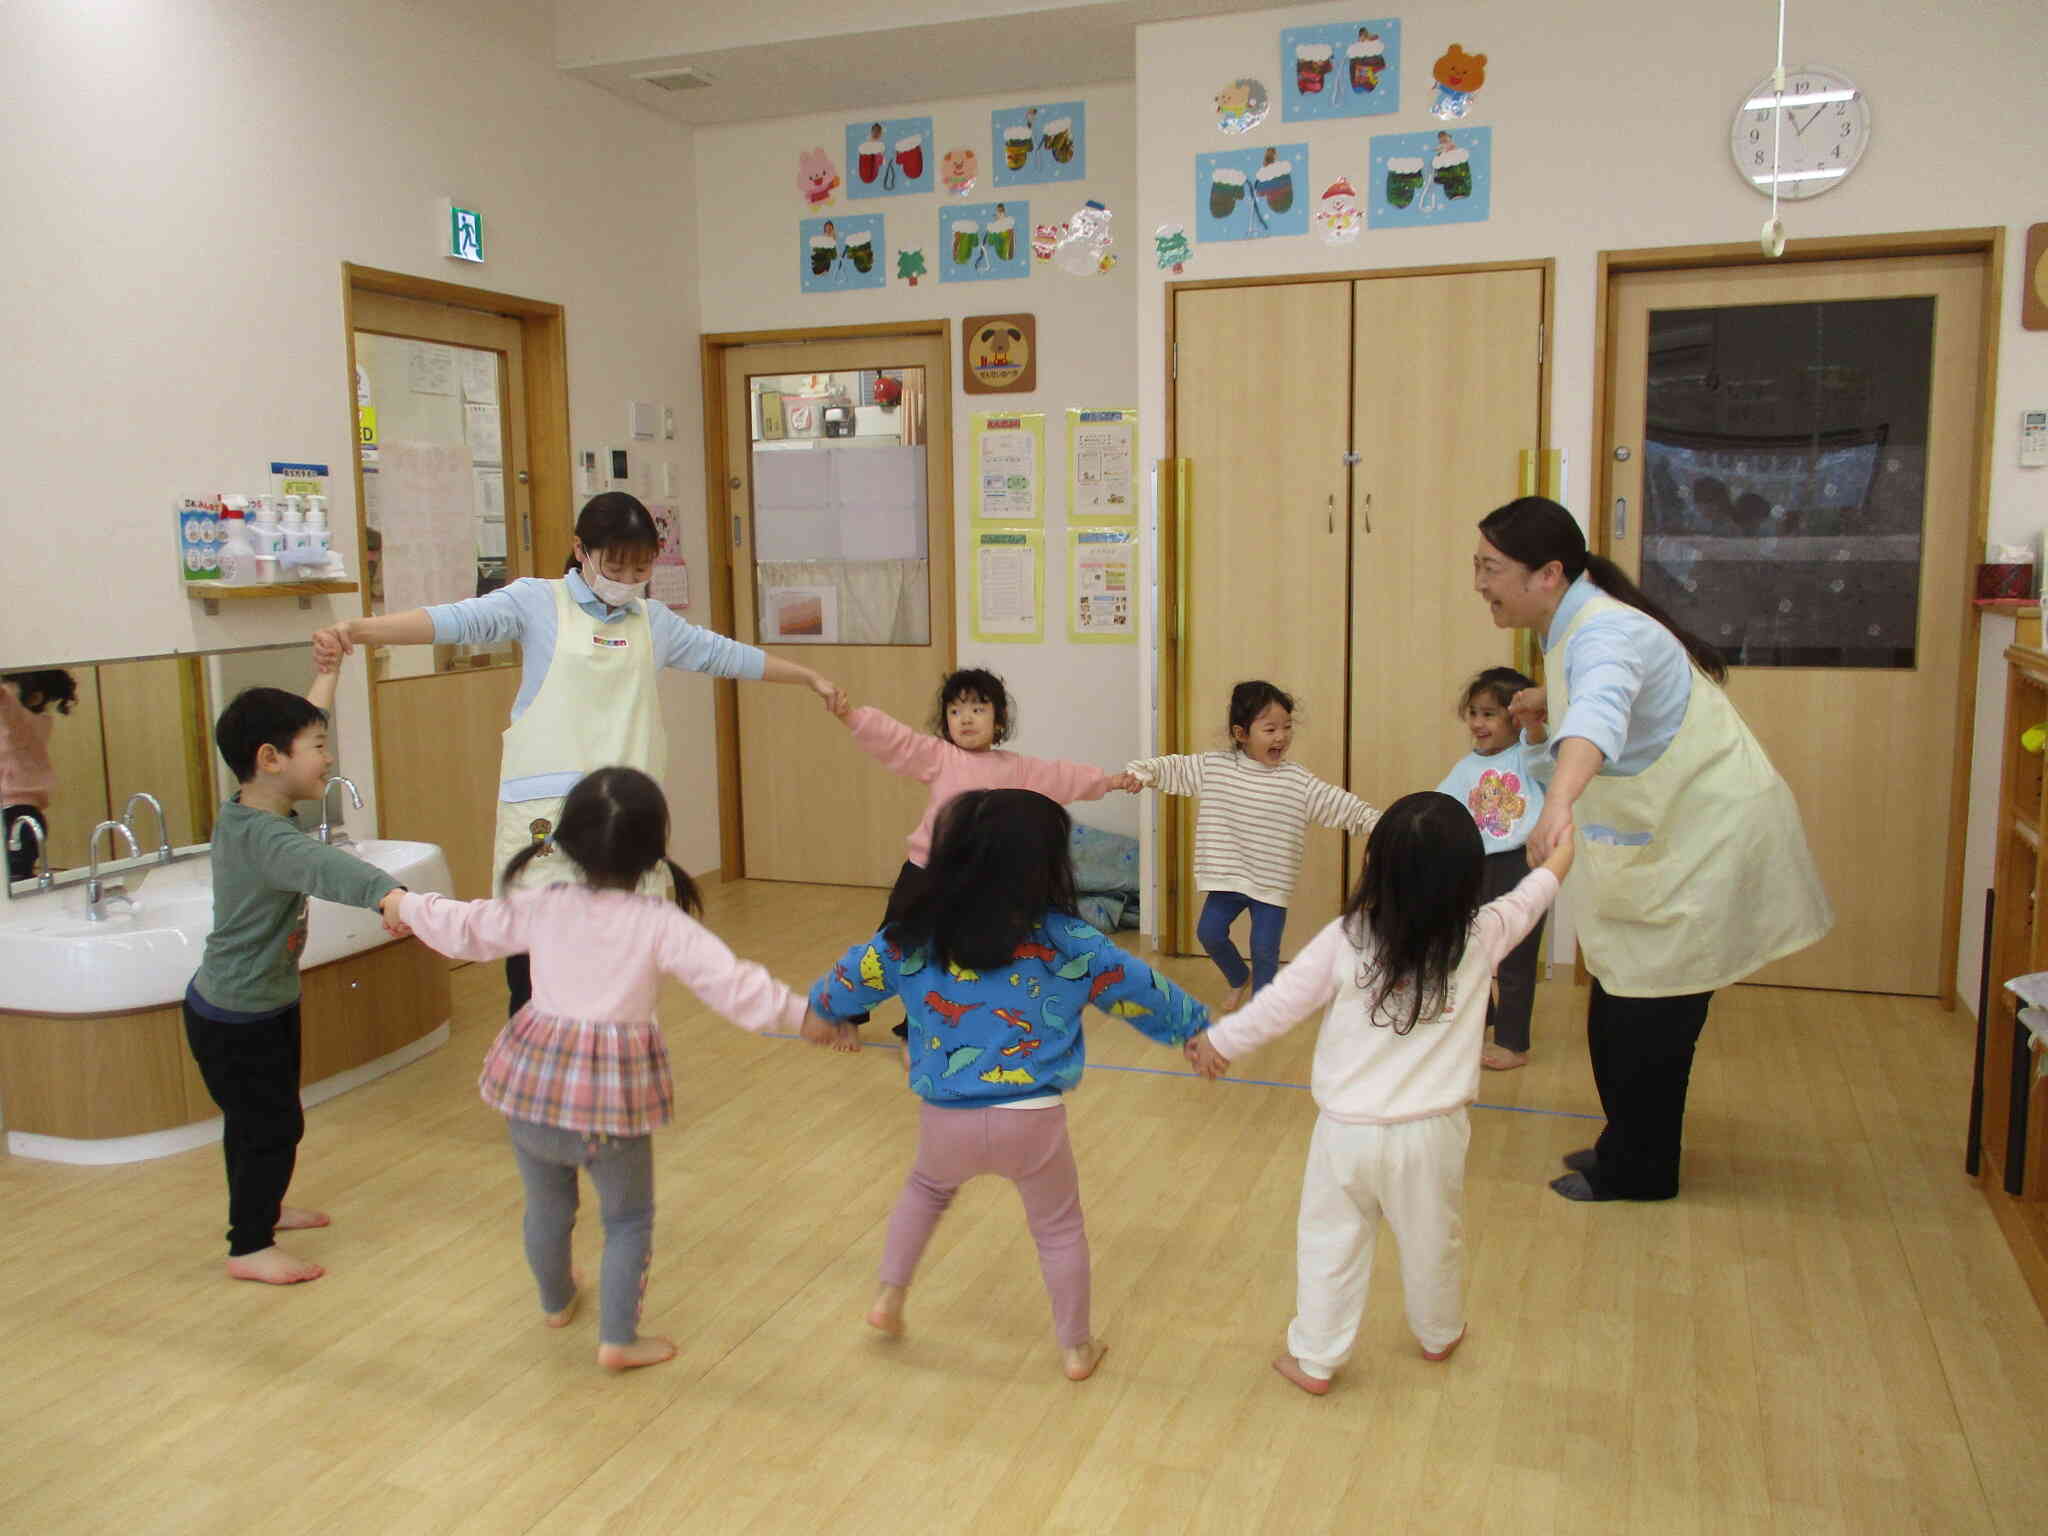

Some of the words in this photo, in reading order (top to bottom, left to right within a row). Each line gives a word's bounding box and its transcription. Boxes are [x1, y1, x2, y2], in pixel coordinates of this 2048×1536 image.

[1749, 129, 1760, 144] 9
[1840, 123, 1851, 137] 3
[1754, 150, 1764, 165] 8
[1831, 144, 1840, 159] 4
